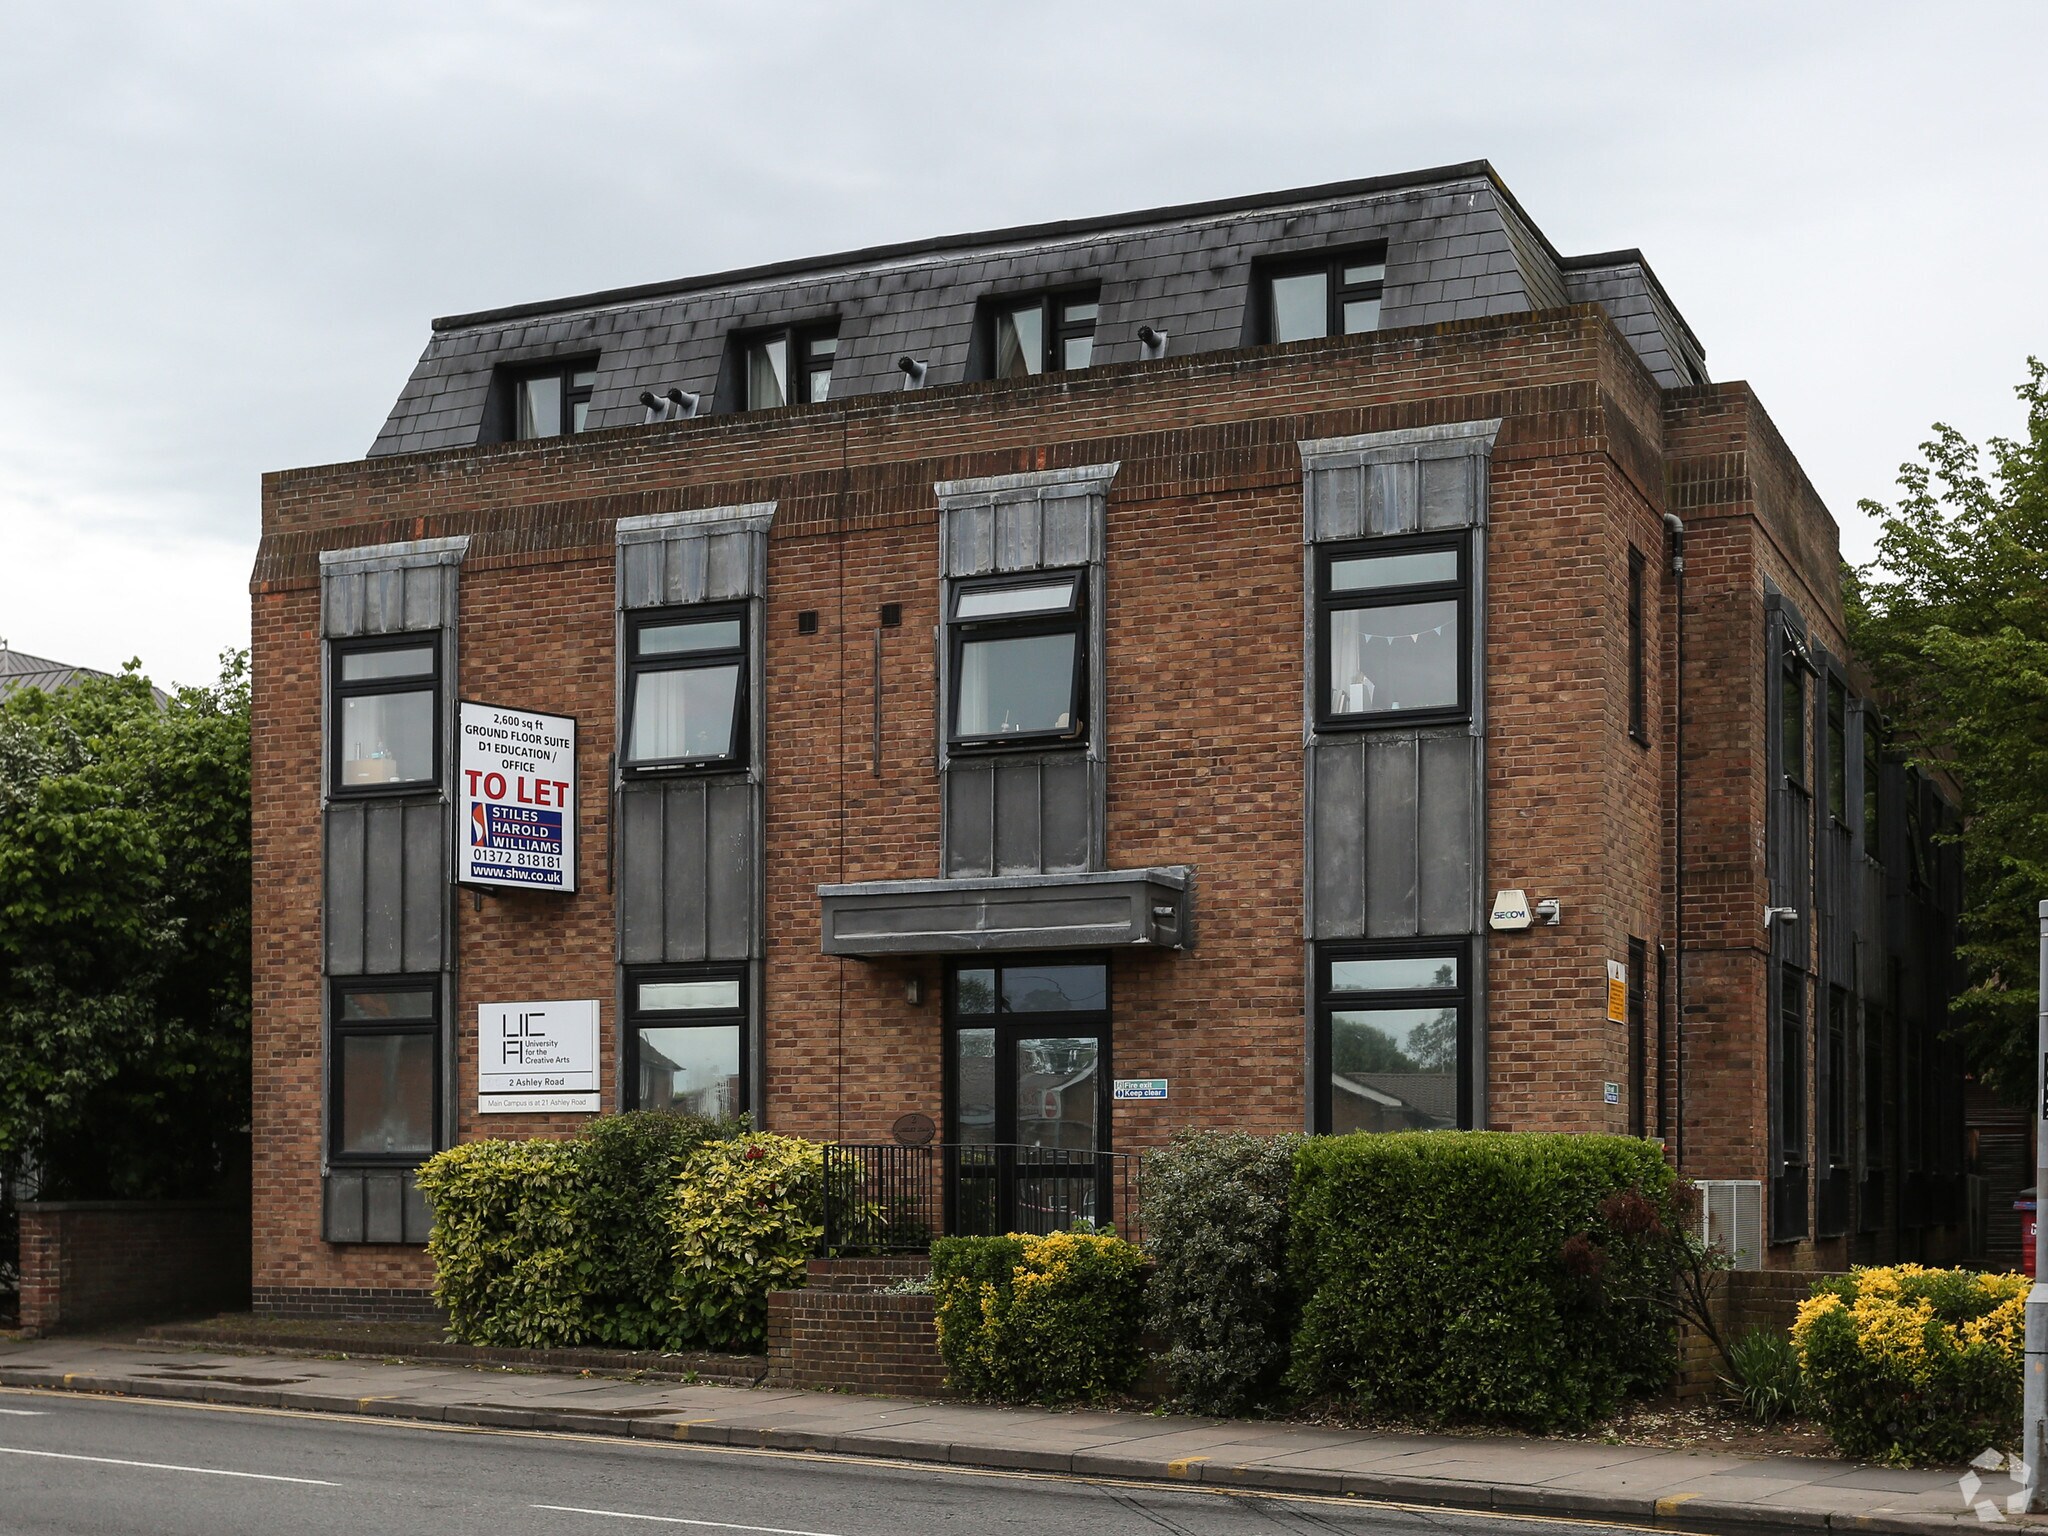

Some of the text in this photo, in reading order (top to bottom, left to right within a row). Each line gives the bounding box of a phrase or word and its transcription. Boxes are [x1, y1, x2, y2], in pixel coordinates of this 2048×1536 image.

[493, 713, 543, 731] 2,600 sq ft
[465, 724, 570, 749] GROUND FLOOR SUITE
[479, 741, 557, 763] D1 EDUCATION /
[501, 759, 535, 773] OFFICE
[465, 769, 569, 808] TO LET
[492, 806, 538, 822] STILES
[492, 821, 549, 838] HAROLD
[492, 836, 560, 854] WILLIAMS
[473, 848, 560, 869] 01372 818181
[473, 865, 561, 883] www.shw.co.uk
[1493, 910, 1525, 919] SECOM
[524, 1039, 559, 1048] University
[525, 1048, 547, 1056] for the
[524, 1056, 570, 1065] Creative Arts
[509, 1077, 565, 1088] 2 Ashley Road
[1124, 1081, 1153, 1089] Fire exit
[1124, 1089, 1162, 1098] Keep clear
[503, 1099, 527, 1107] Campus
[550, 1098, 570, 1107] Ashley
[571, 1098, 587, 1106] Road
